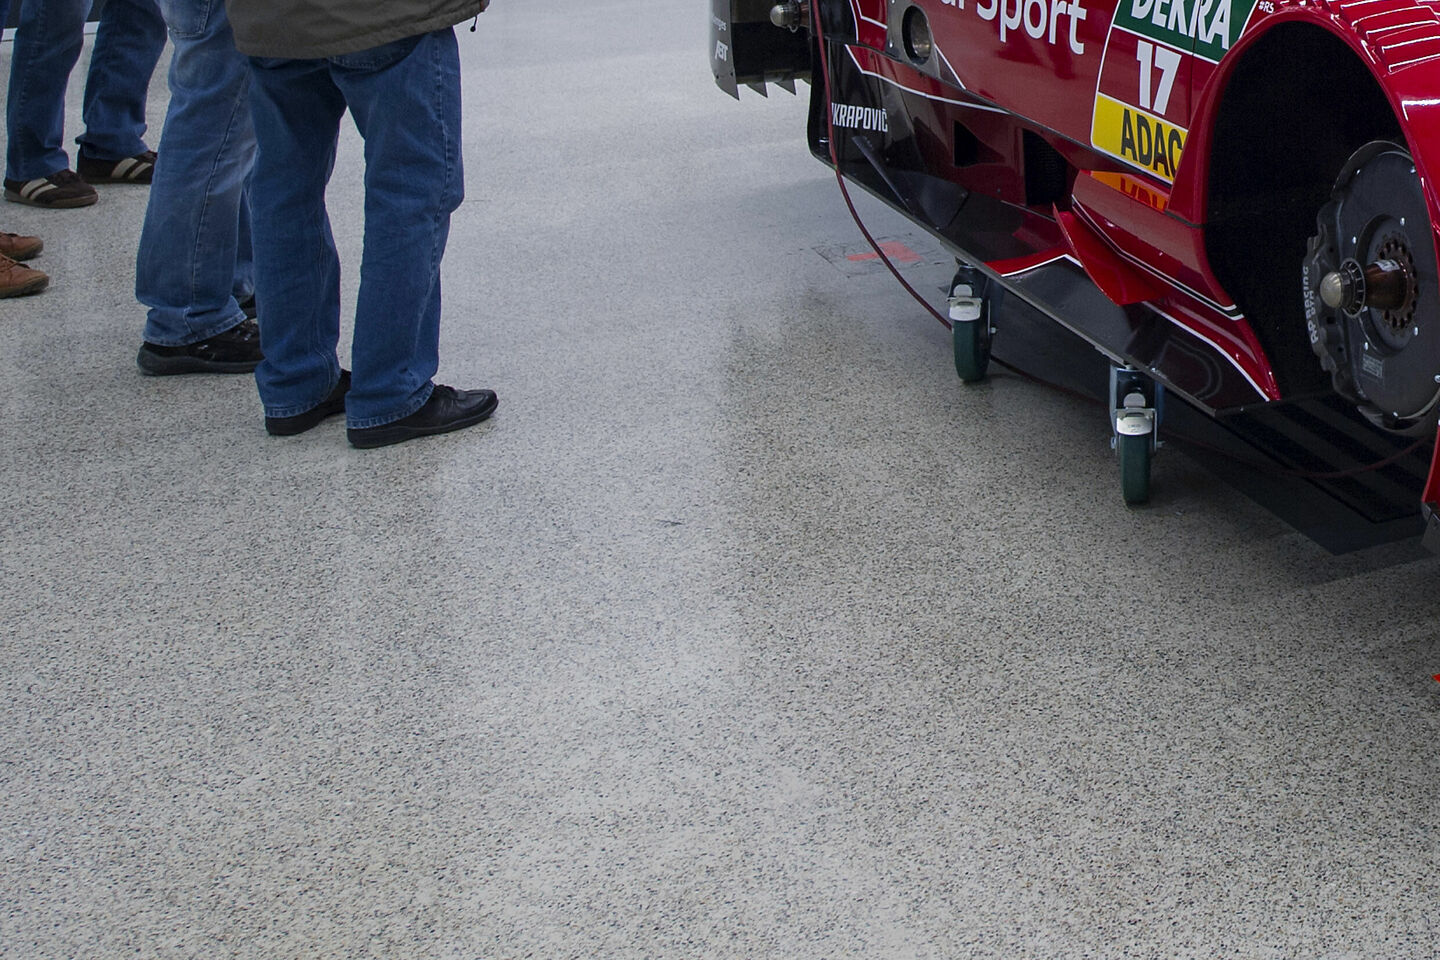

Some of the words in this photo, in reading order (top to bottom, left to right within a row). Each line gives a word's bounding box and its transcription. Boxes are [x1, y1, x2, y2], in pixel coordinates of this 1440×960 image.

[1136, 39, 1182, 116] 17
[831, 102, 888, 133] KRAPOVIČ
[1120, 108, 1183, 178] ADAC
